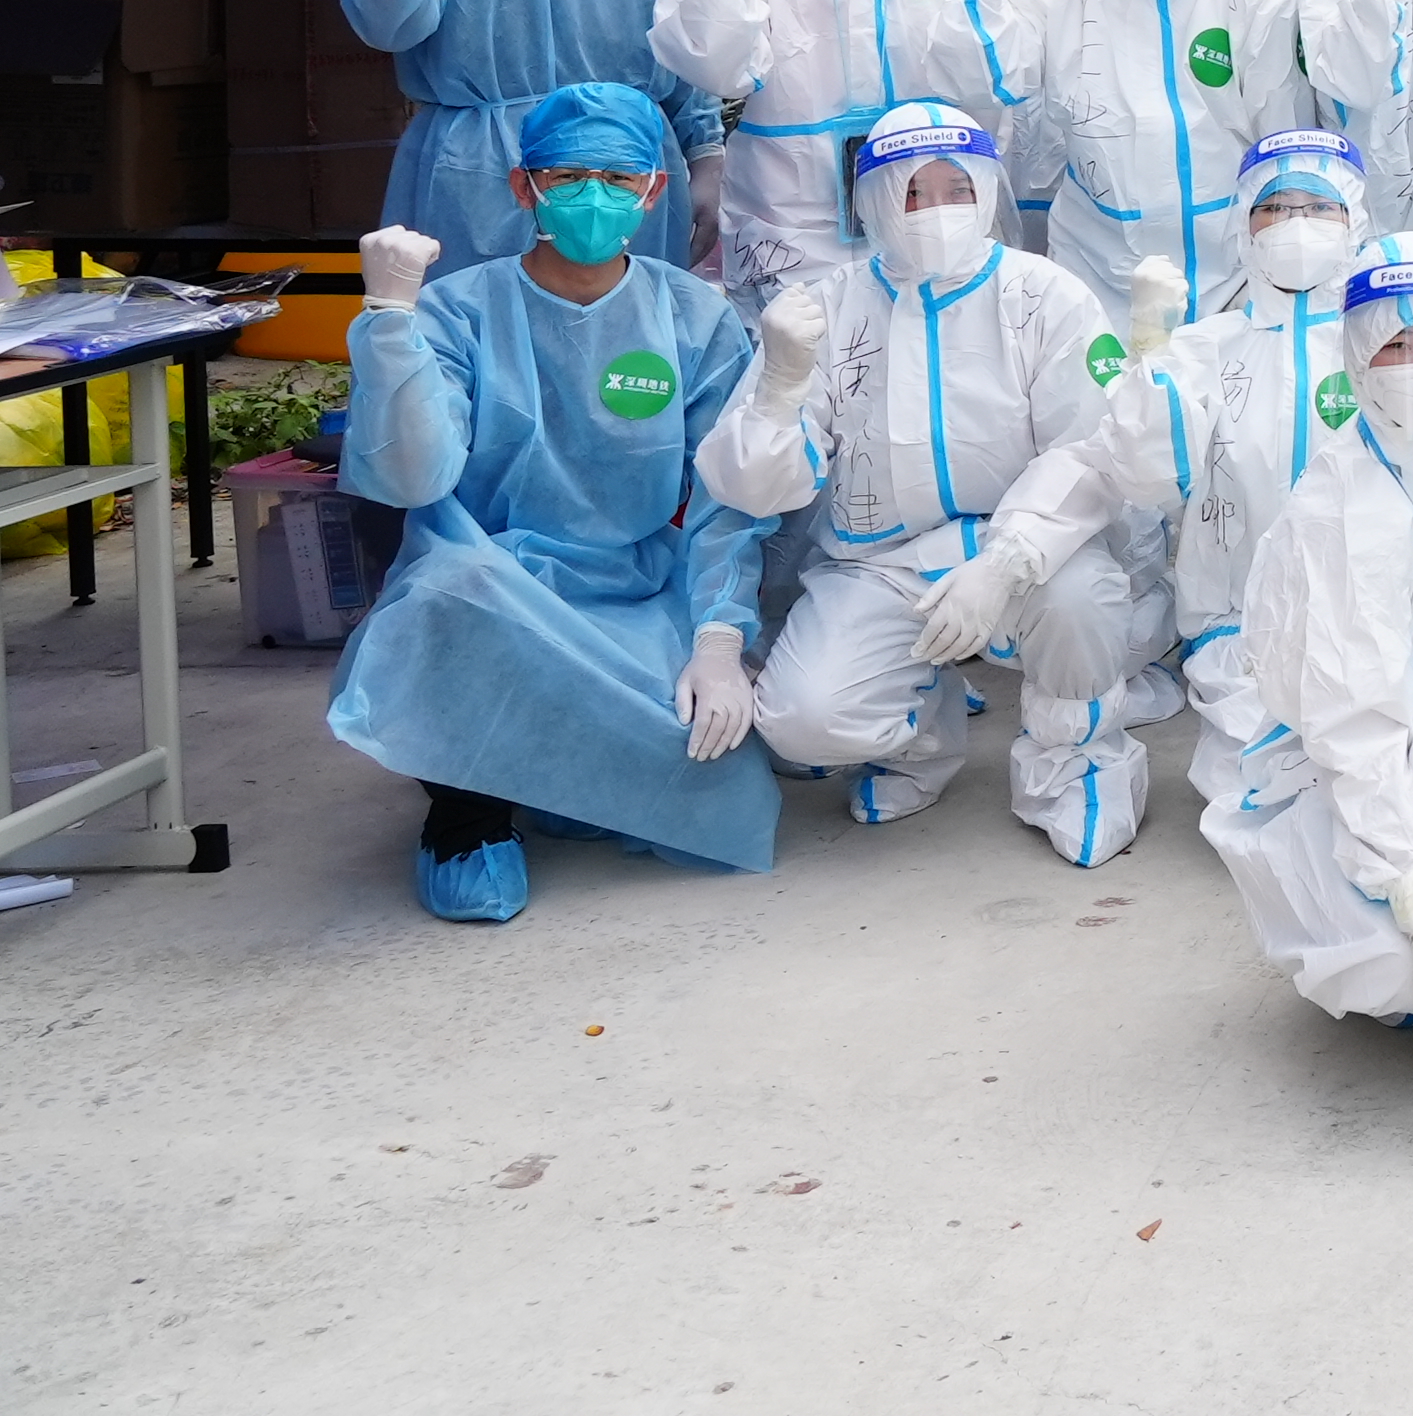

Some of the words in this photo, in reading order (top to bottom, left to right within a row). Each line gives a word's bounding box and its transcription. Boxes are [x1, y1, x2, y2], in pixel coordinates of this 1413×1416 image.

[881, 139, 906, 152] Face
[911, 132, 953, 145] Shield
[1267, 137, 1294, 148] Face
[1298, 134, 1336, 146] Shield
[1381, 272, 1413, 282] Face
[624, 375, 670, 391] 深圳地铁
